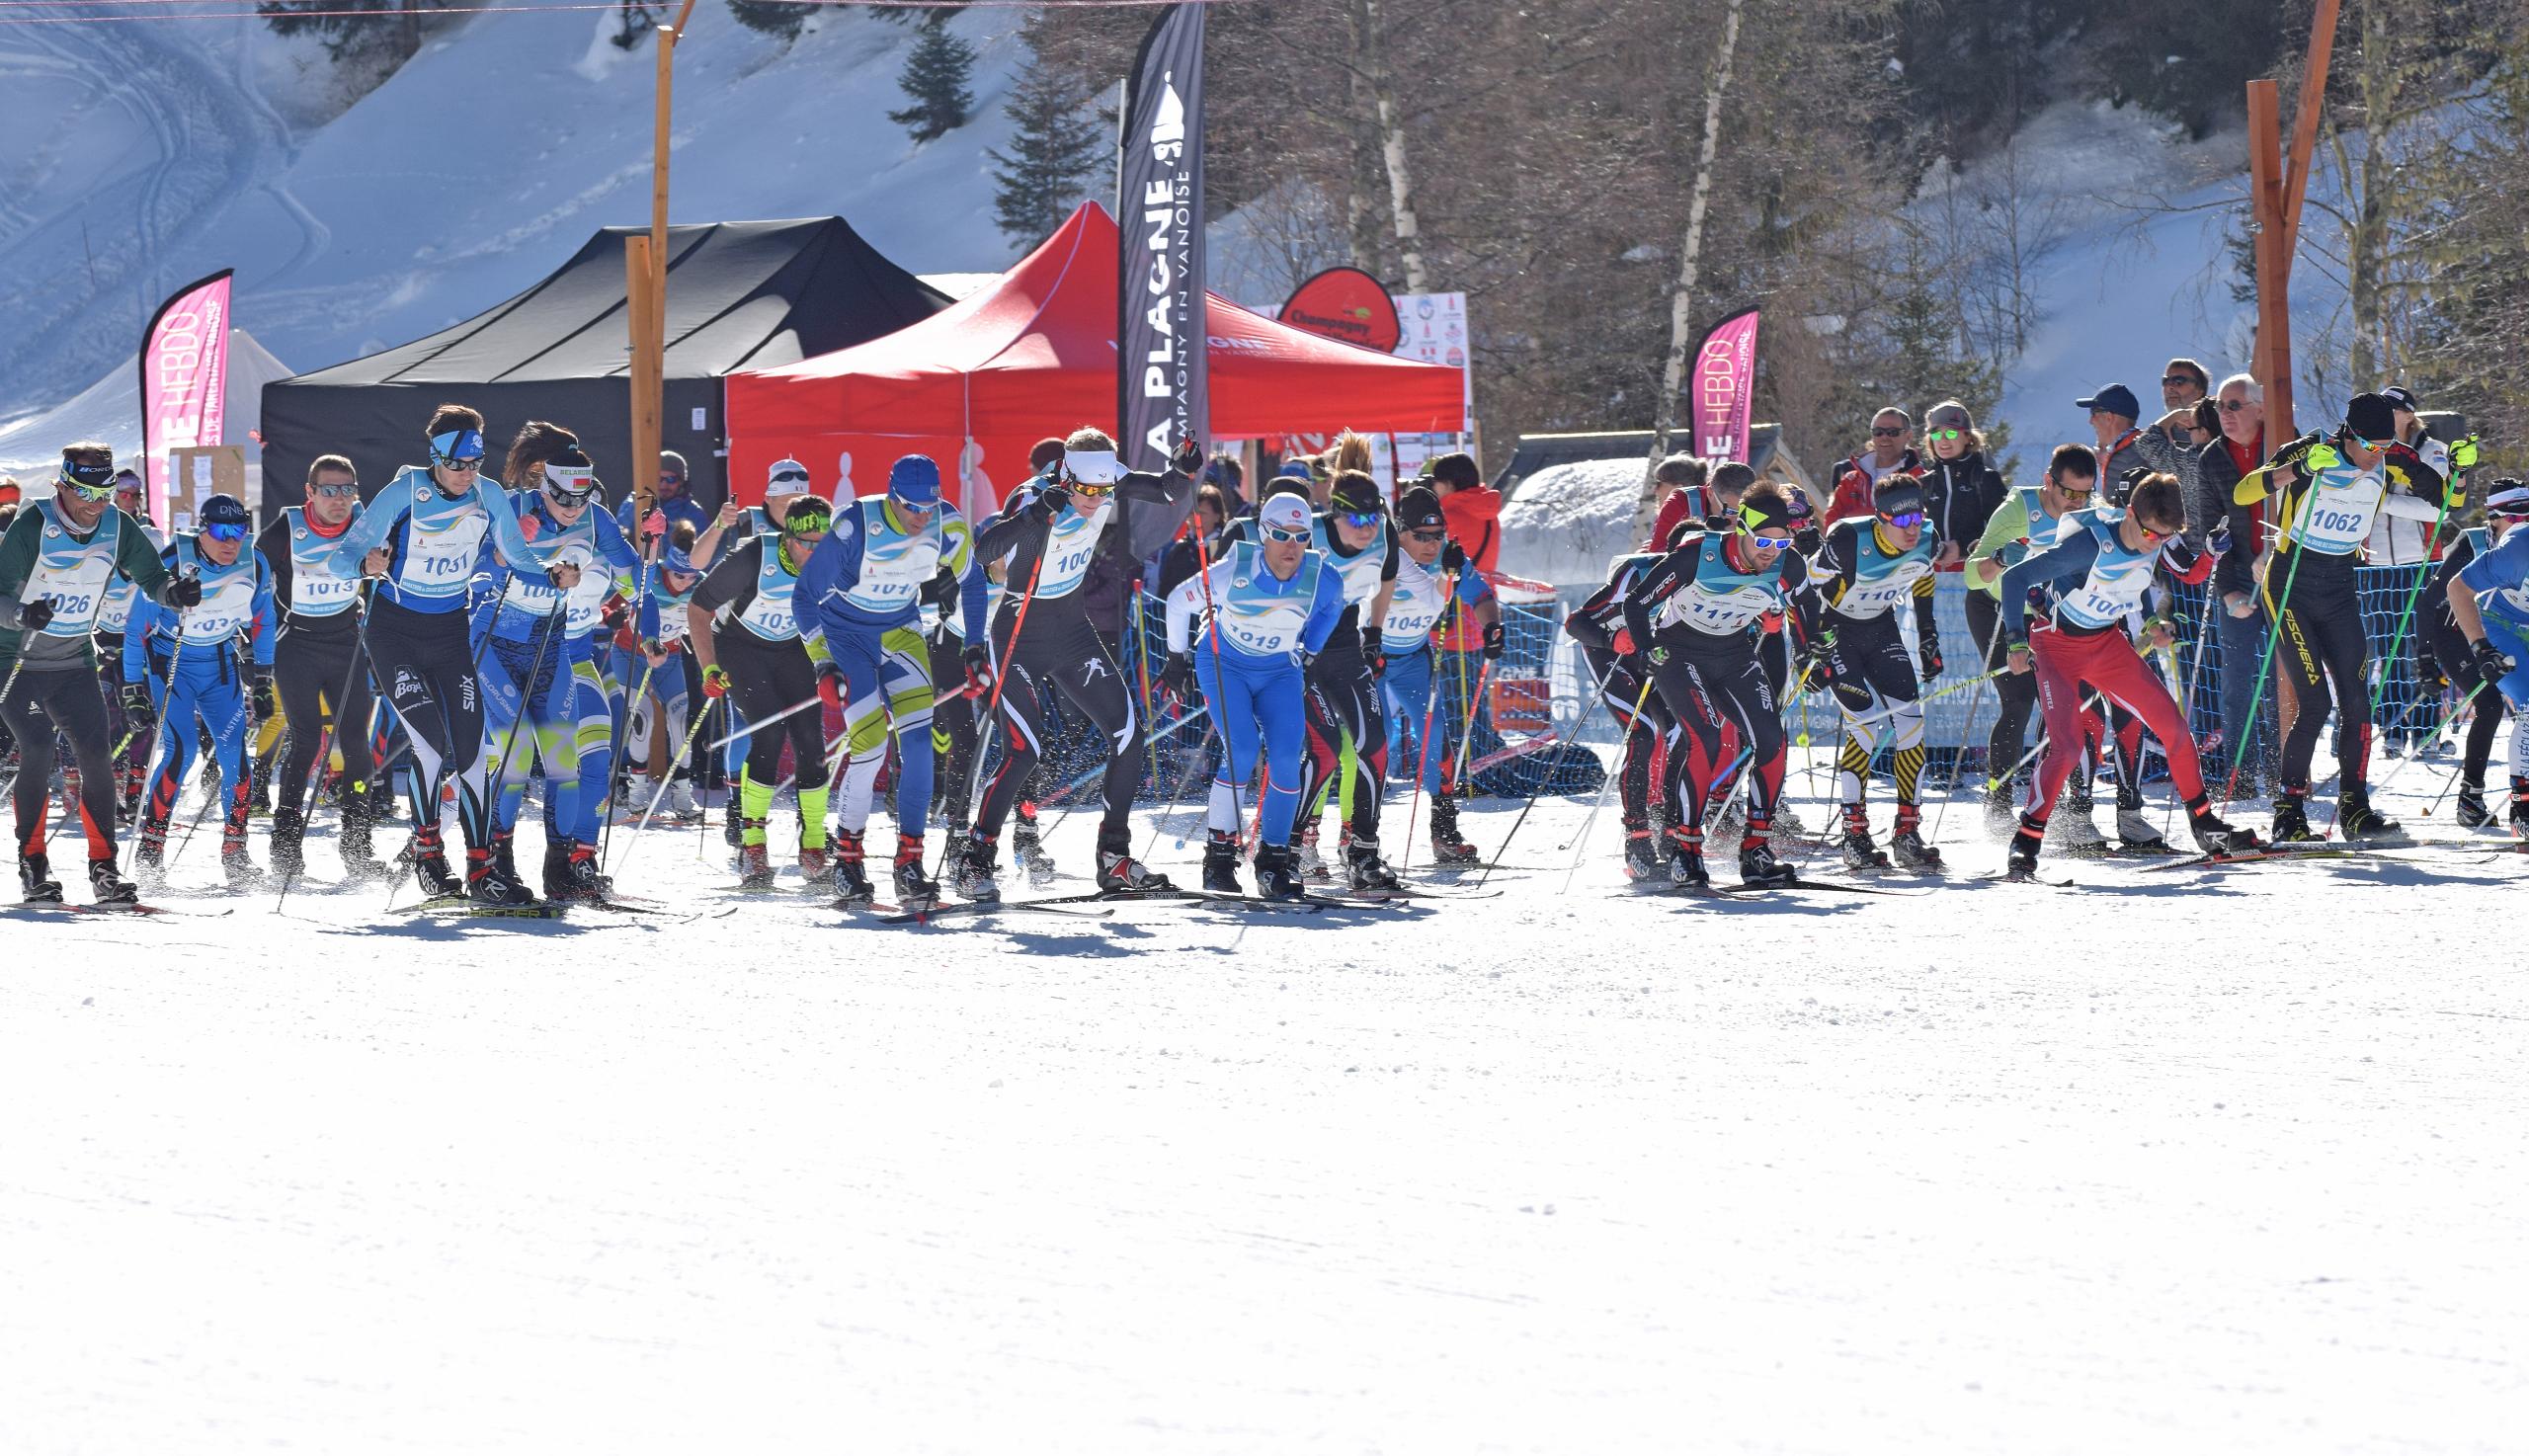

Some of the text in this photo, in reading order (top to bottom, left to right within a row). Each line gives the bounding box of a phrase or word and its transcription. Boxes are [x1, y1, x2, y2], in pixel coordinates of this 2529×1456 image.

[1144, 179, 1174, 397] PLAGNE
[1175, 170, 1190, 438] MPAGNY EN VANOISE
[159, 311, 200, 407] HEBDO
[1704, 339, 1736, 425] HEBDO
[2314, 509, 2362, 532] 1062
[306, 580, 354, 596] 1013
[1388, 613, 1434, 630] 1043
[1693, 603, 1748, 620] 1111
[2283, 608, 2316, 672] FISCHER
[459, 675, 475, 713] SWIX
[1758, 682, 1773, 712] SWIX
[1836, 682, 1871, 699] TRIMTEX
[2043, 680, 2055, 710] TRIMTEX
[418, 864, 440, 895] ROSSI
[1144, 892, 1180, 901] salomon
